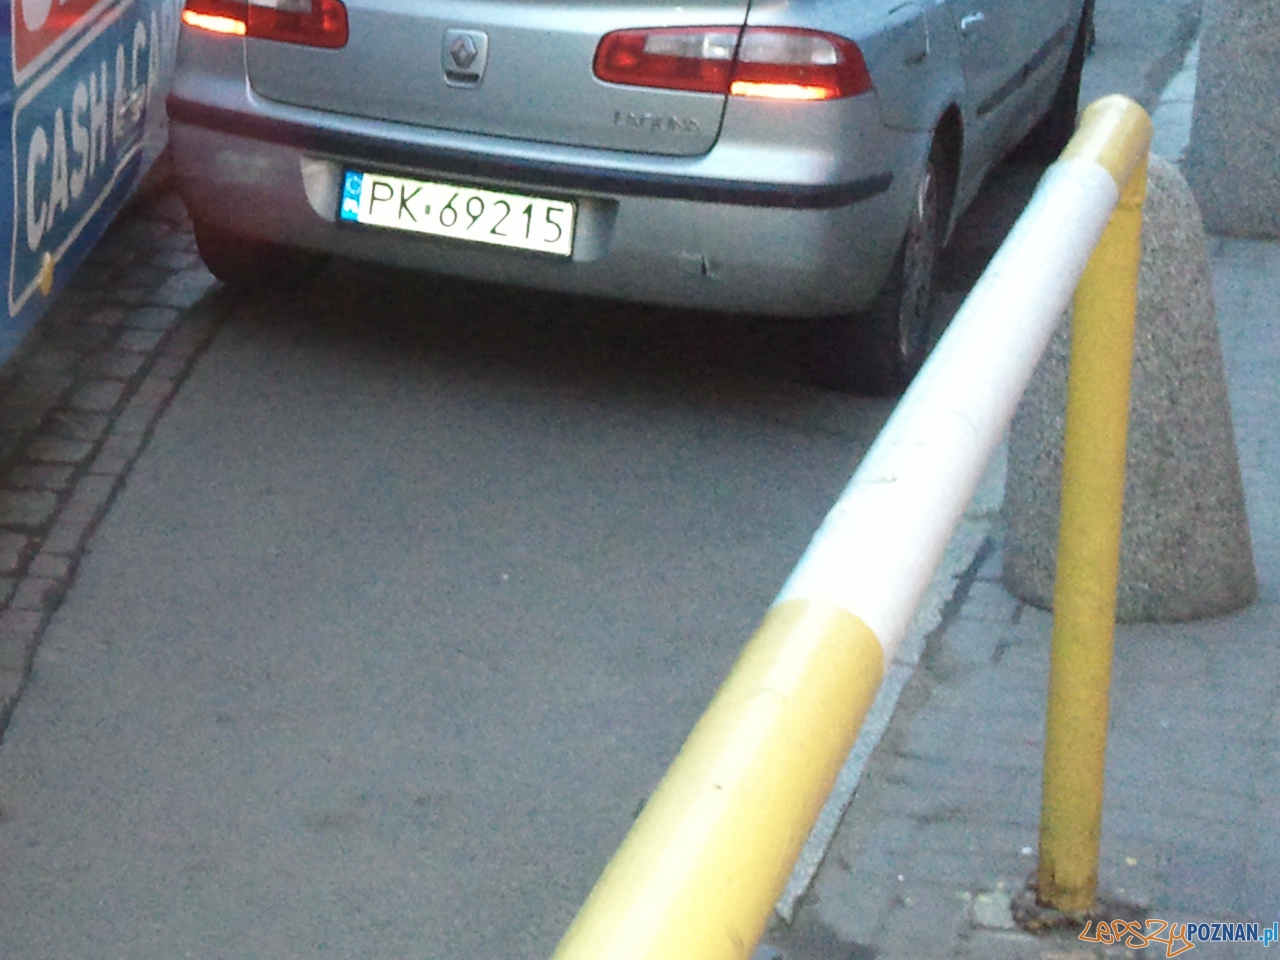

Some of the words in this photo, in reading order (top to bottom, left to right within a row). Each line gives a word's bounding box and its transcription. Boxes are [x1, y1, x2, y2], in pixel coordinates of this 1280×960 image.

[26, 61, 109, 251] CASH
[369, 181, 423, 223] PK
[438, 192, 565, 243] 69215
